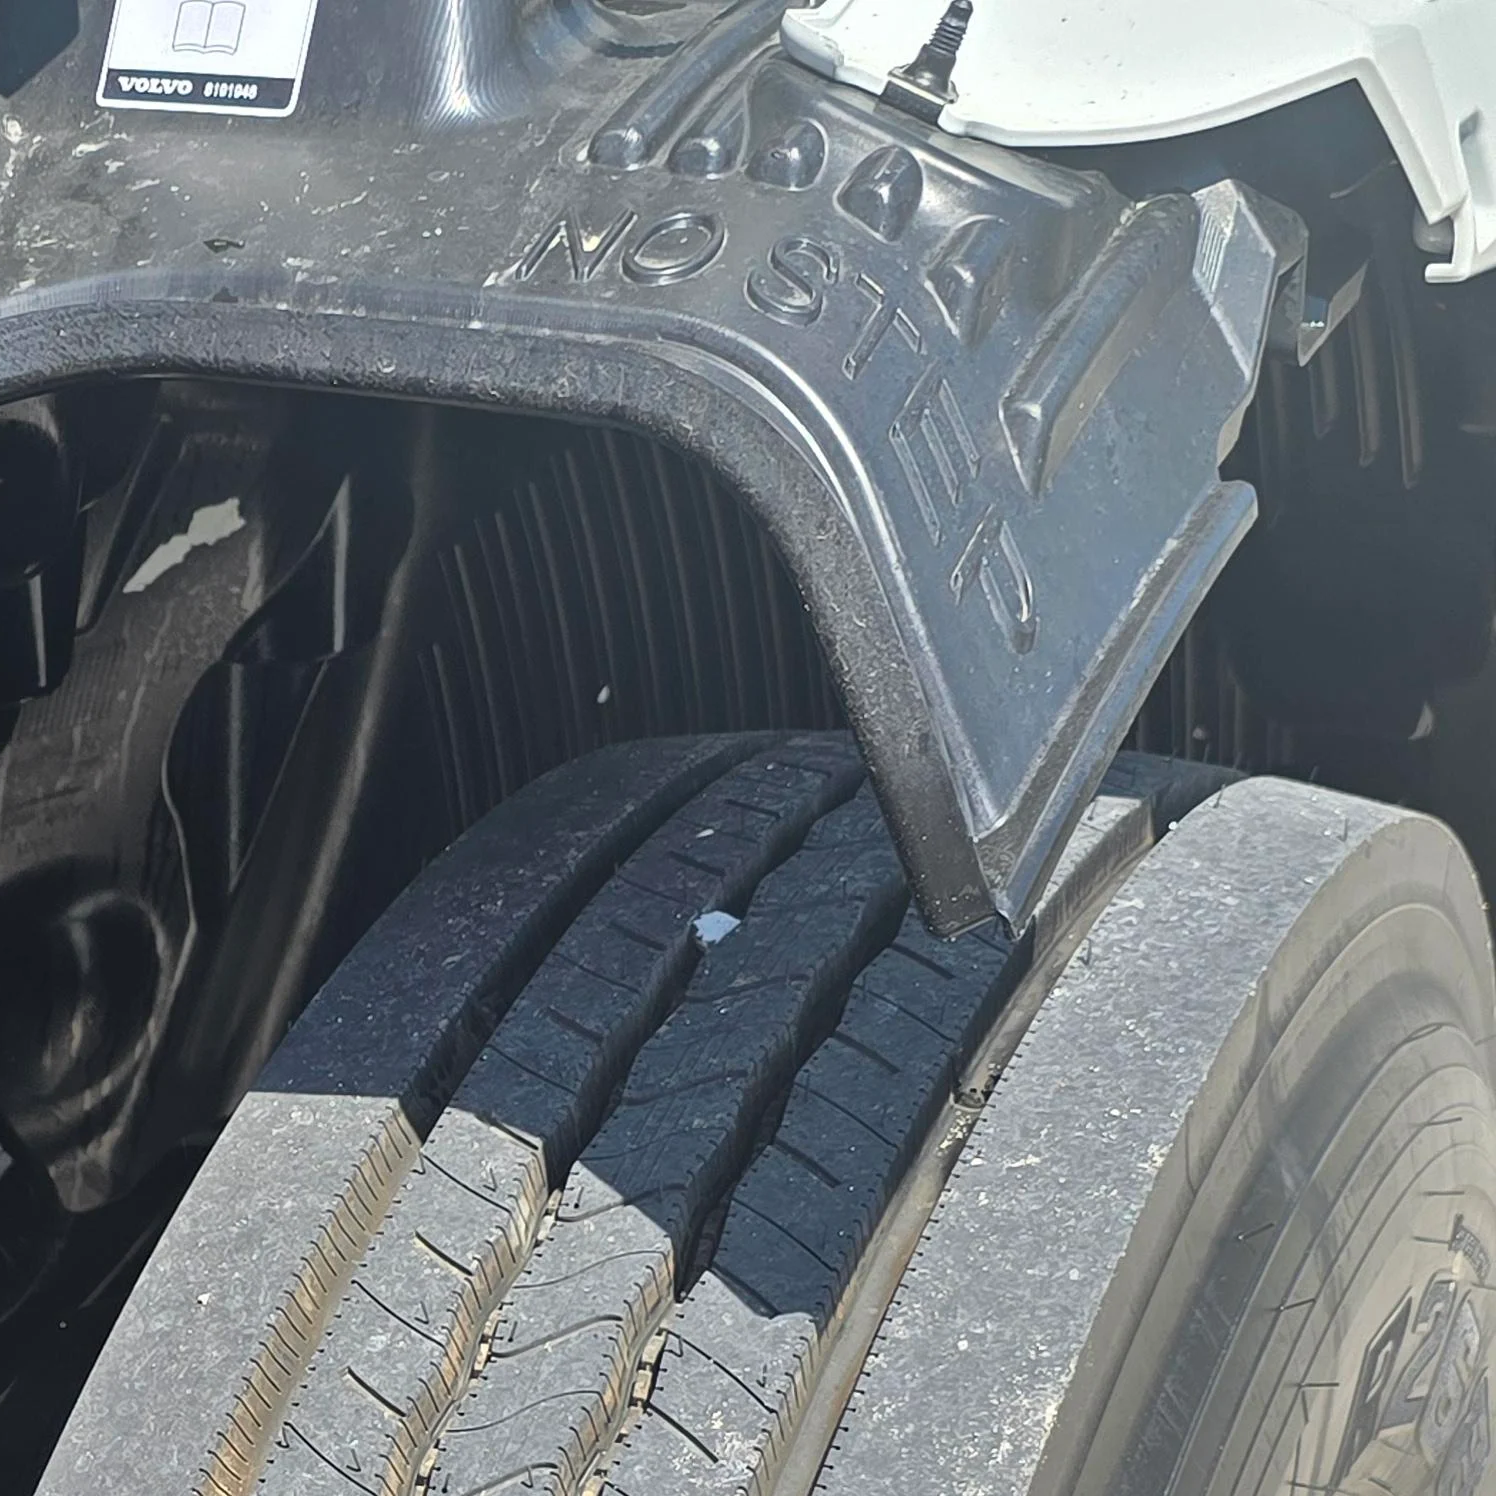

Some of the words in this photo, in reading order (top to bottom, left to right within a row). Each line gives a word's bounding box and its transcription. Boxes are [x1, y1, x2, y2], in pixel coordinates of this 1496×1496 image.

[118, 76, 193, 95] VOLVO
[511, 205, 727, 287] NO
[744, 236, 1041, 656] STEP
